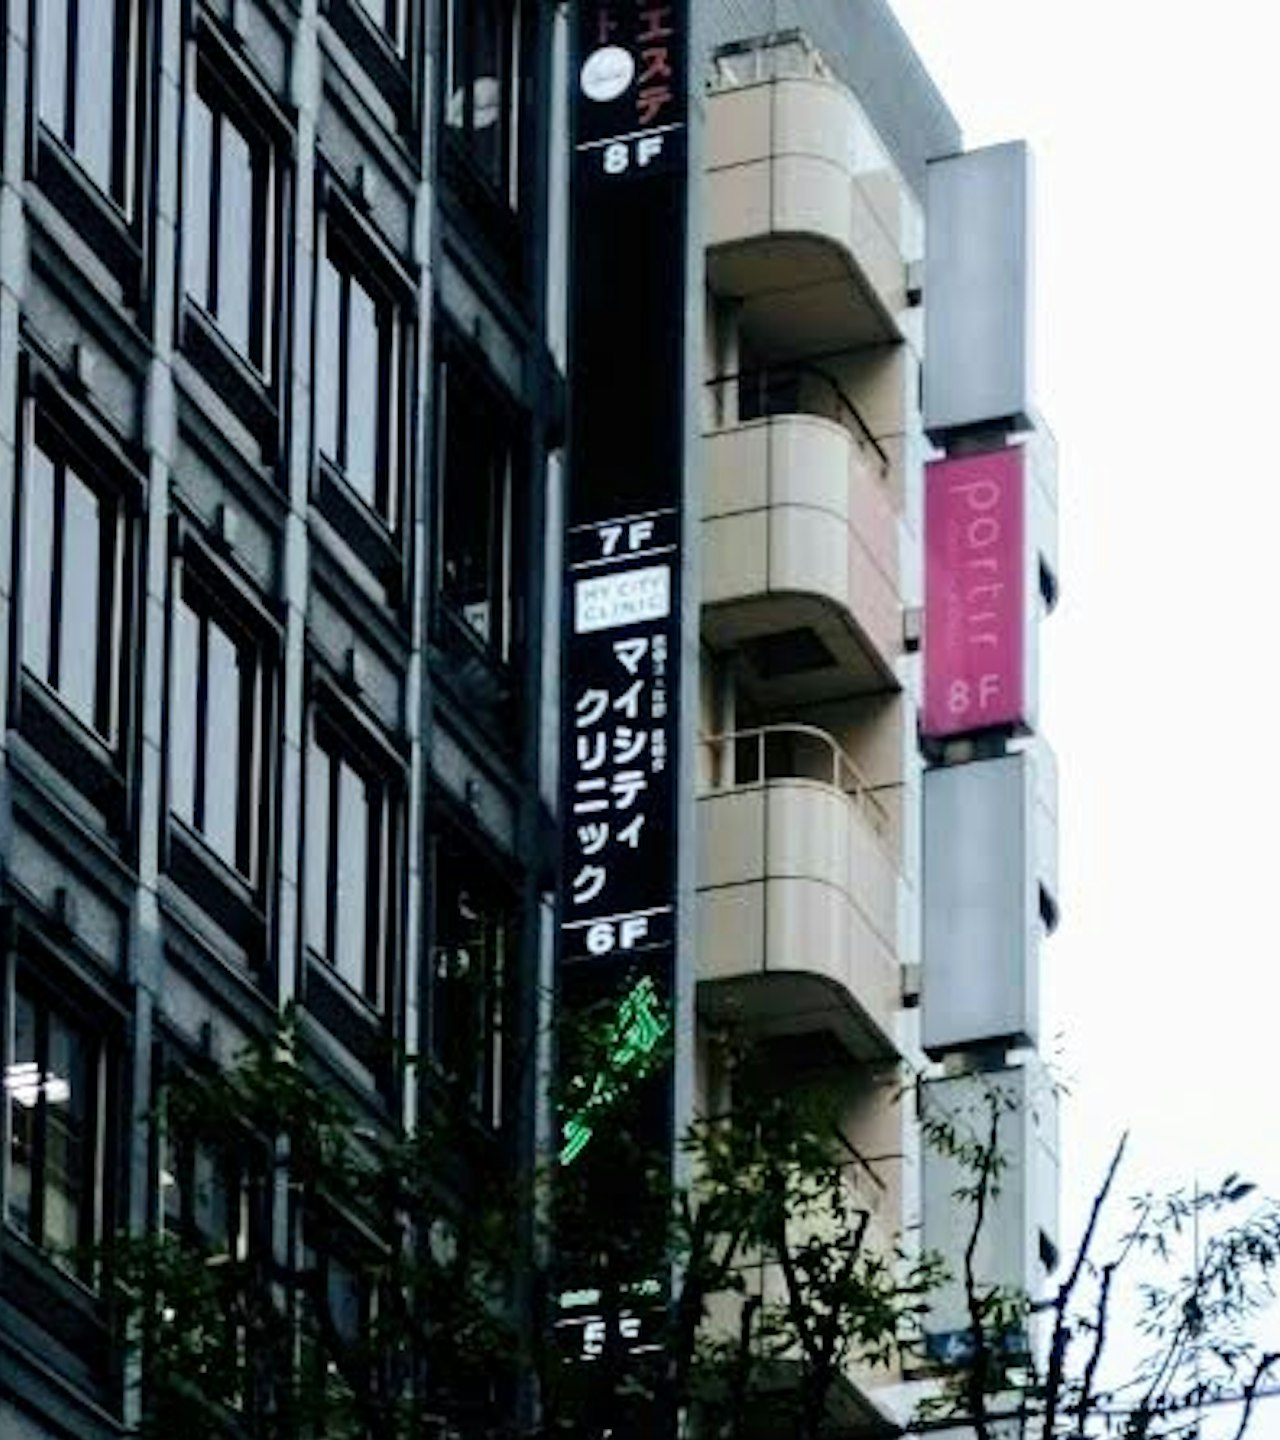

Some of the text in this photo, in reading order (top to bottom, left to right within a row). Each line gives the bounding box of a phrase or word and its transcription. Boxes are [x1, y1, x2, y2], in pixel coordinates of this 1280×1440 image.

[602, 134, 665, 175] 8F
[598, 521, 654, 556] 7F
[948, 673, 999, 713] 8F
[609, 638, 649, 849] マイシティ
[573, 688, 610, 905] クリニック
[586, 916, 649, 955] 6F
